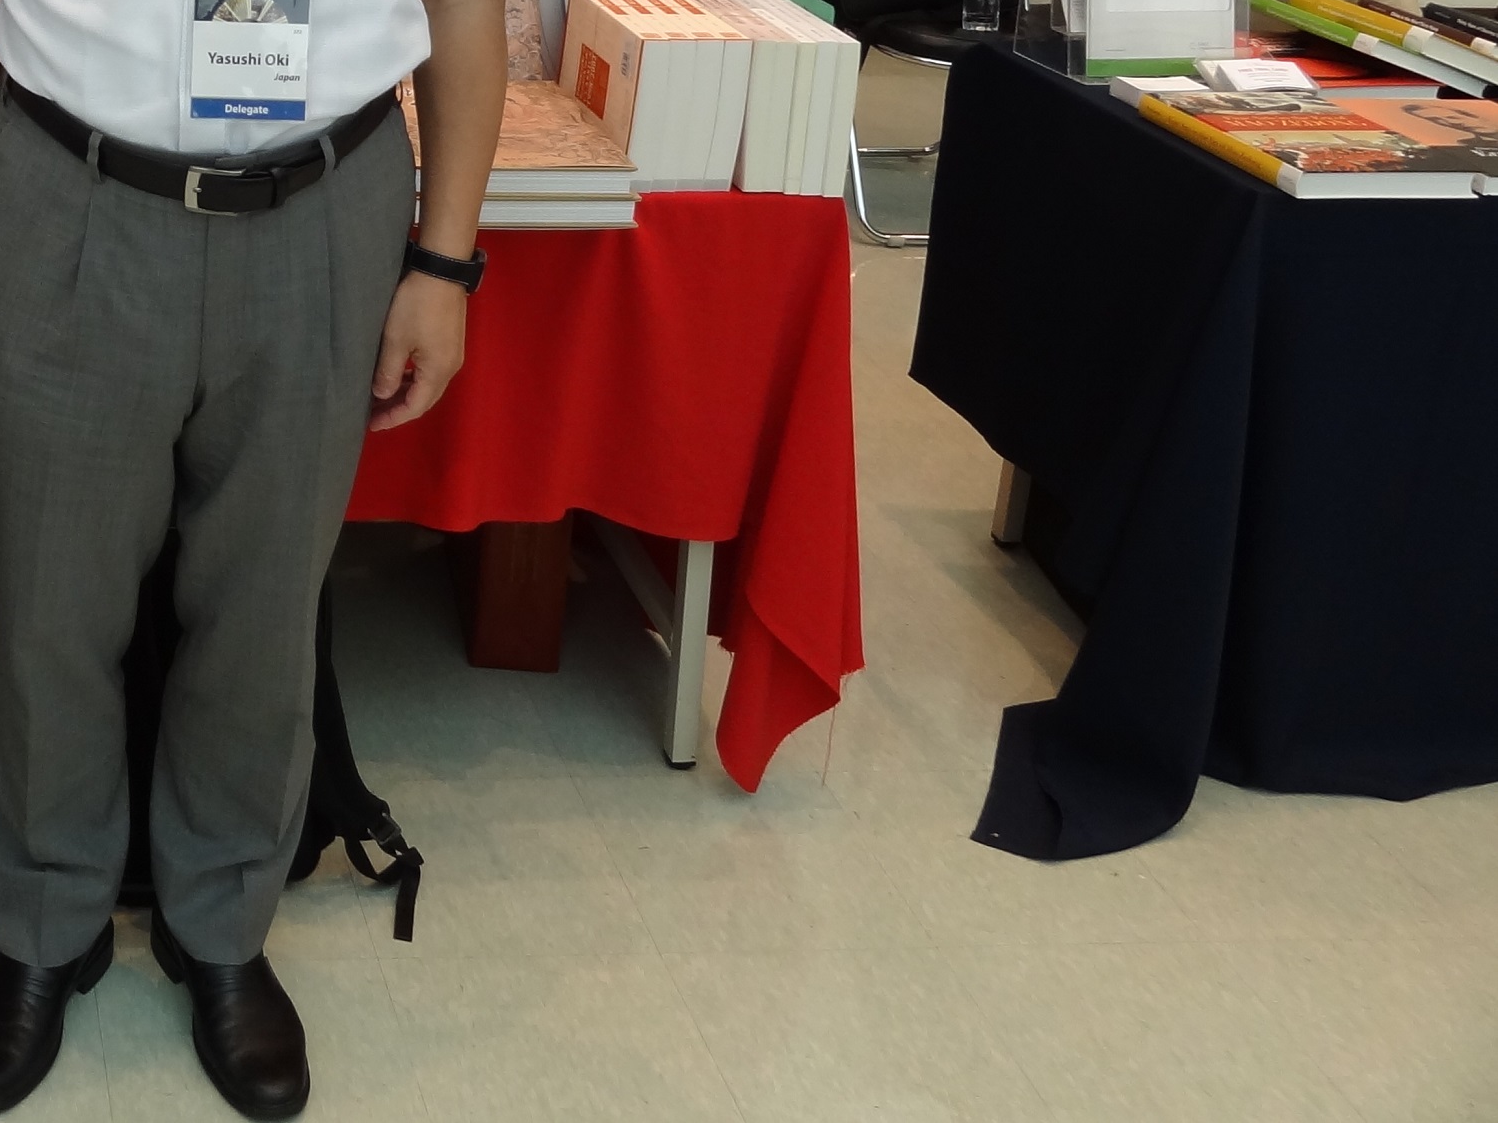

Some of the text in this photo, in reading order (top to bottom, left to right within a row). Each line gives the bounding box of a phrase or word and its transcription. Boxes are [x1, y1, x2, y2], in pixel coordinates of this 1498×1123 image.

[208, 51, 289, 67] Yasushi Oki
[274, 73, 300, 83] Japan
[224, 104, 269, 115] Delegate
